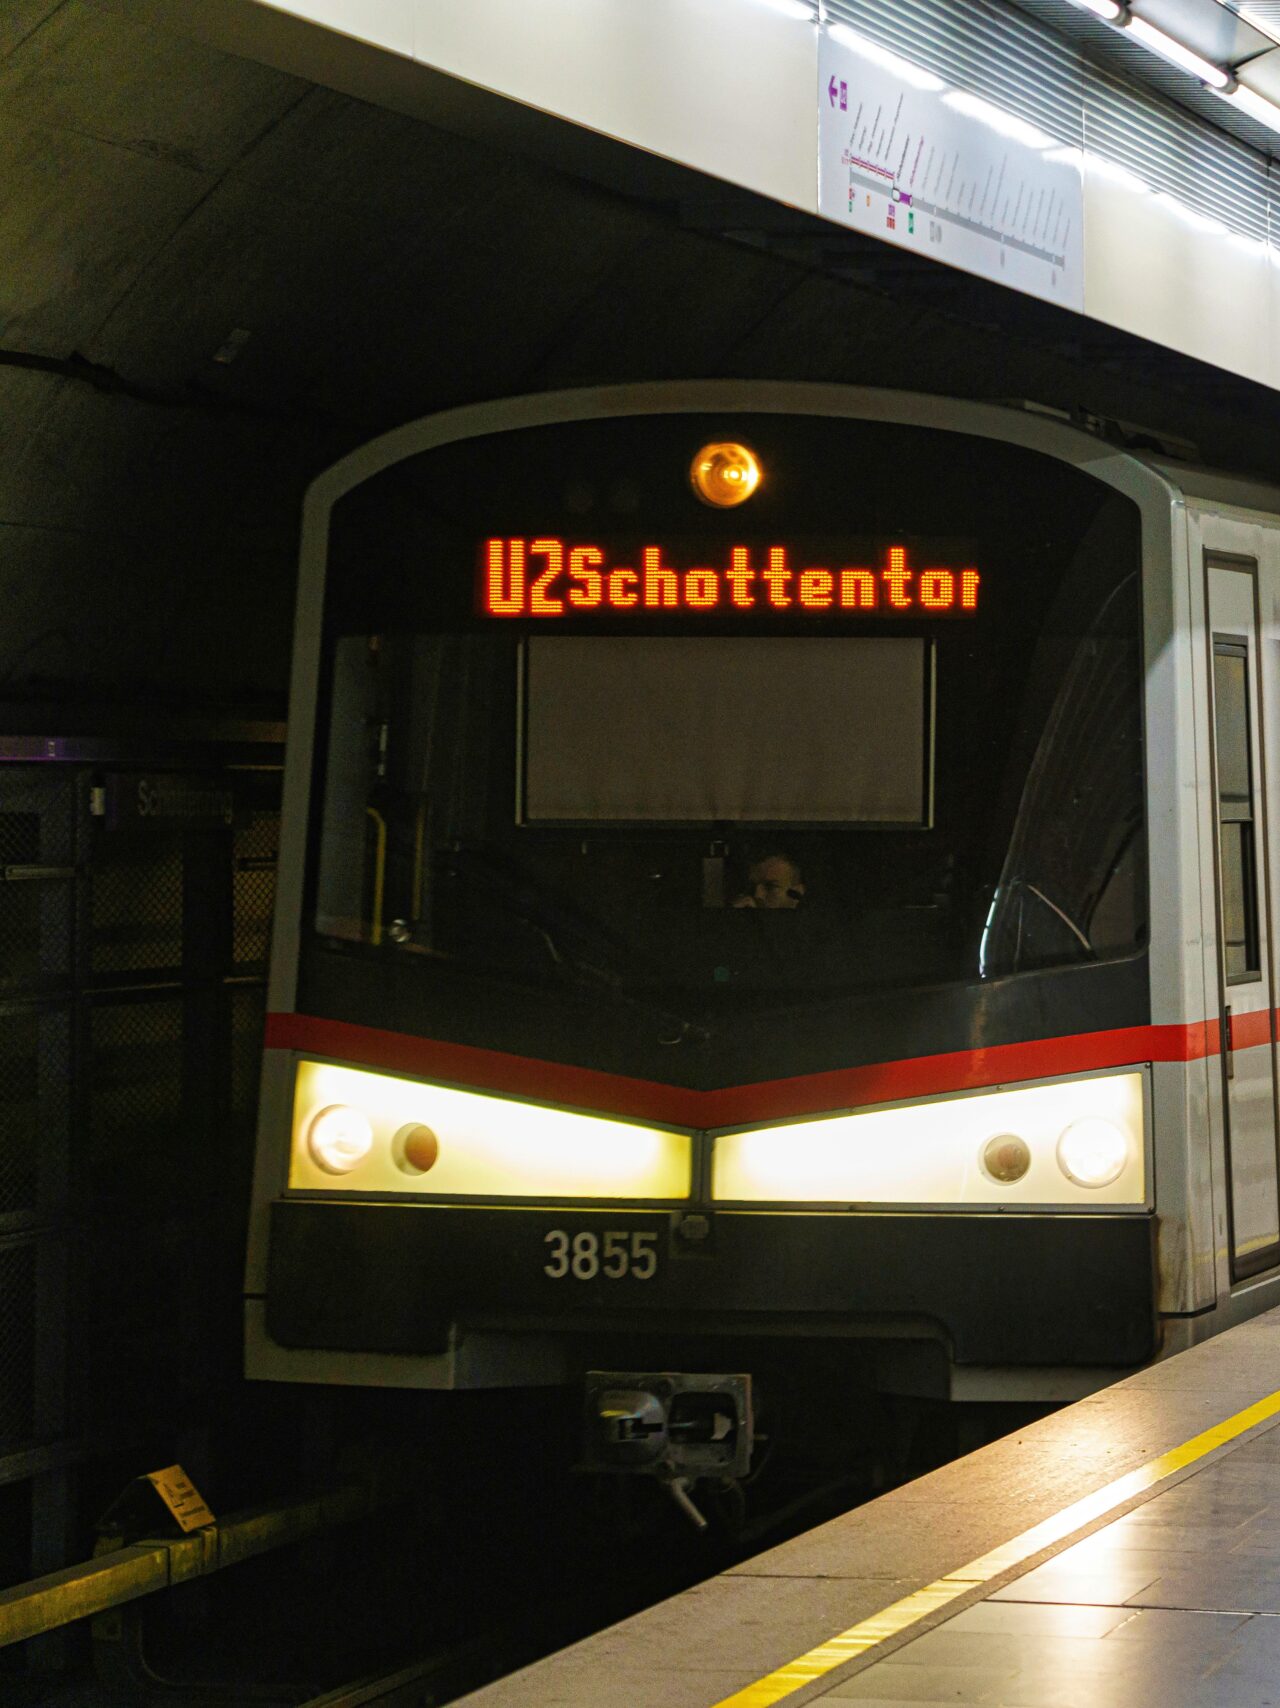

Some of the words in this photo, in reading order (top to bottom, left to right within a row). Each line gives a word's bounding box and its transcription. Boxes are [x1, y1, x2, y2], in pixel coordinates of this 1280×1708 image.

[488, 539, 563, 613] U2
[569, 547, 980, 607] Schottentor
[544, 1230, 658, 1280] 3855
